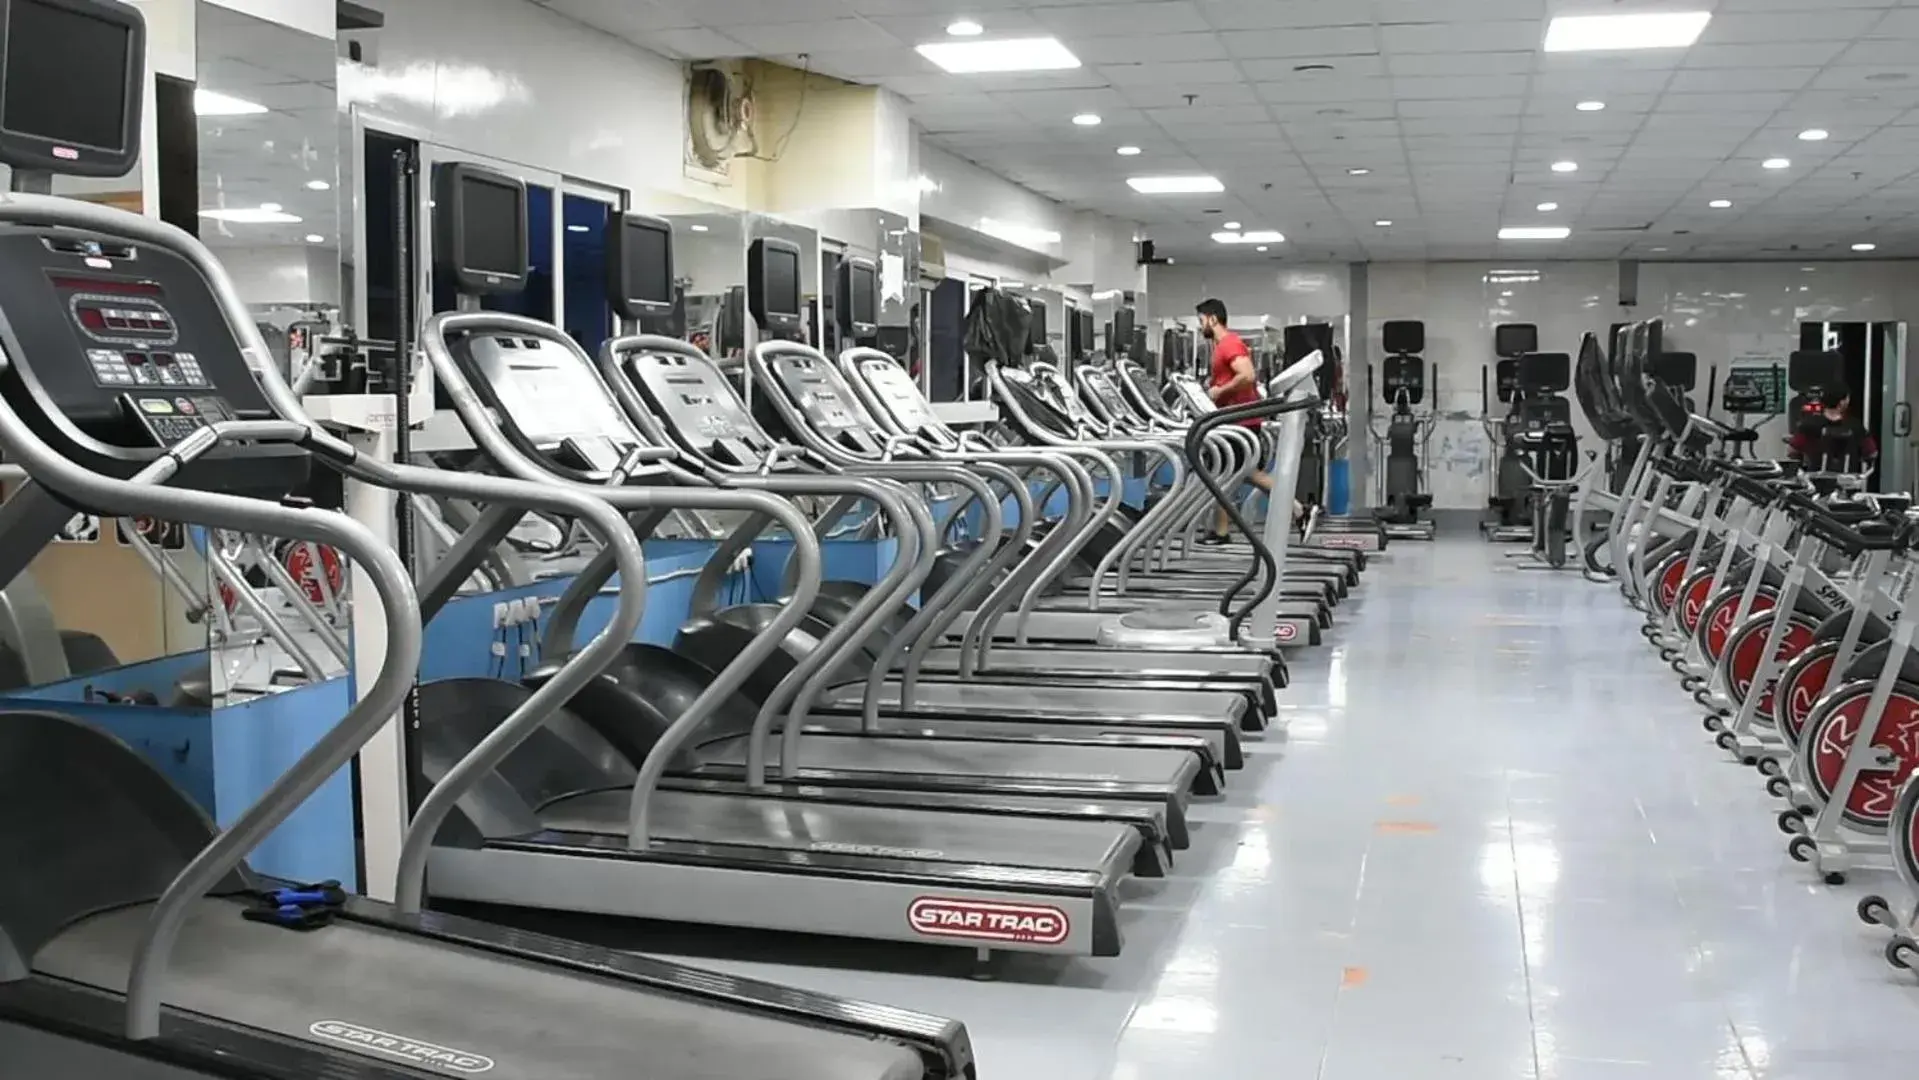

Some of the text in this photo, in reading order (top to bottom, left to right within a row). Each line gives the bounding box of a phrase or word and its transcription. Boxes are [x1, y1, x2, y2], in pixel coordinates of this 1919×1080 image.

[919, 909, 1055, 933] STAR TRAC
[321, 1024, 480, 1067] STAR TRAC
